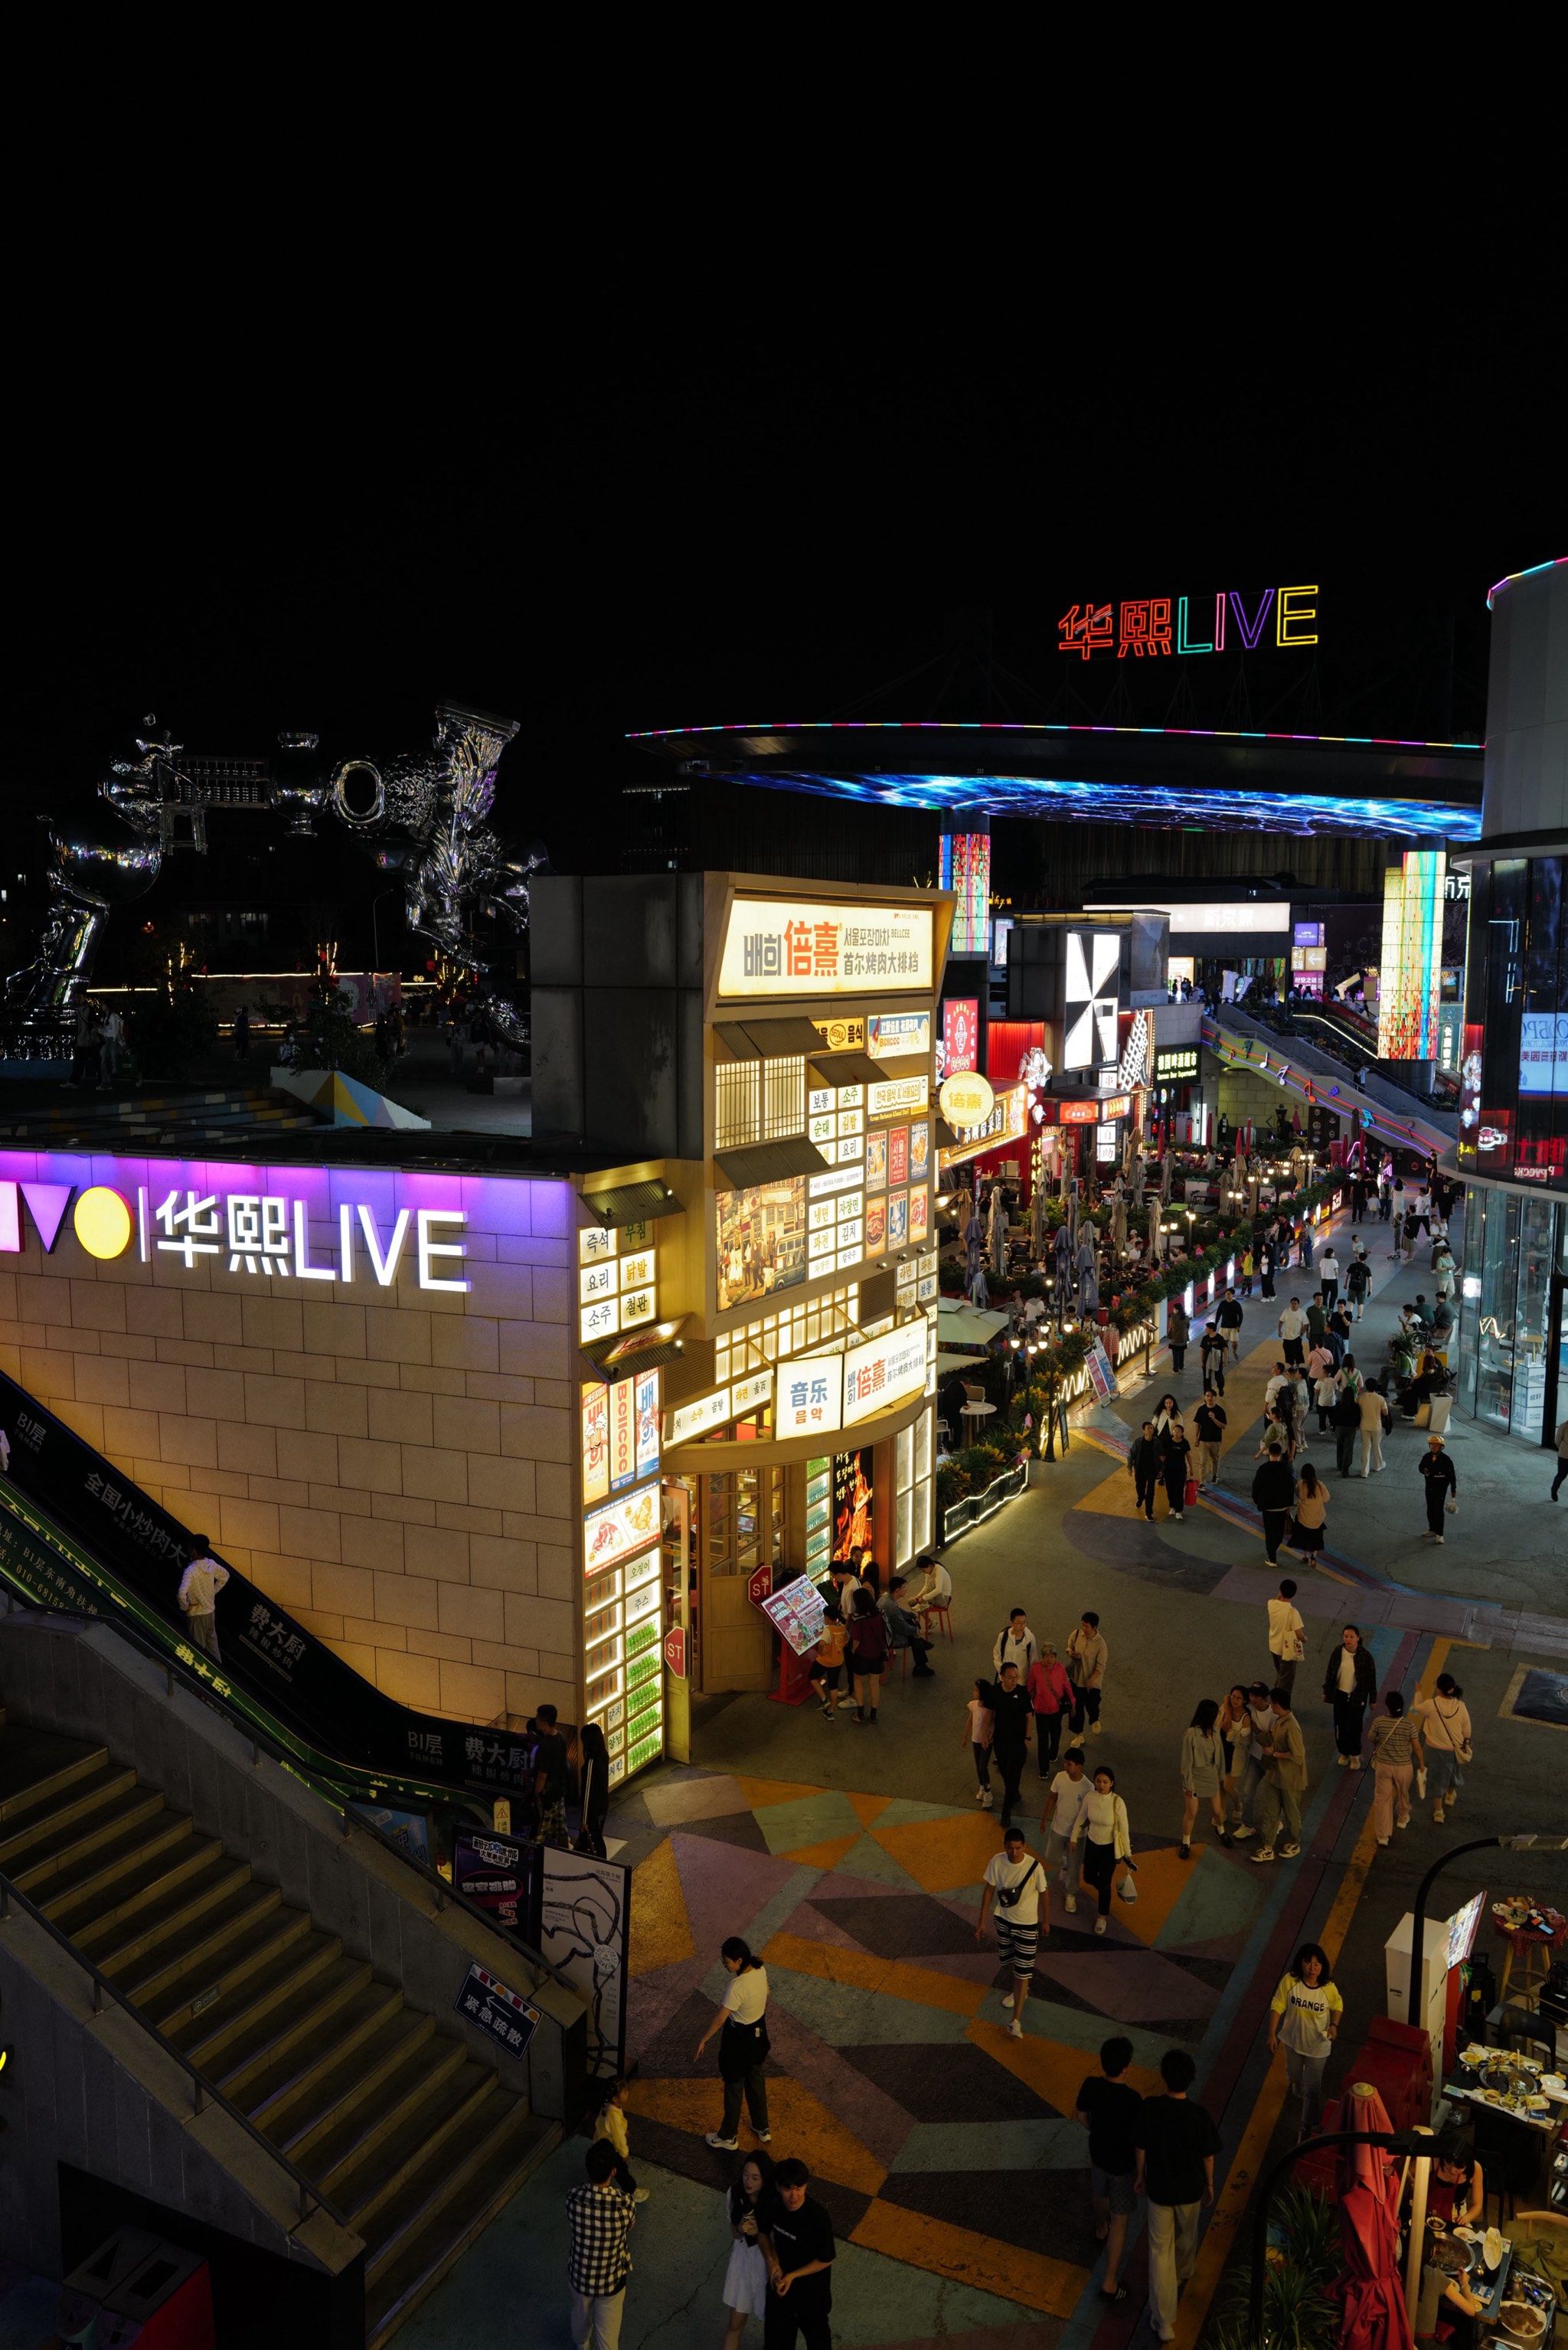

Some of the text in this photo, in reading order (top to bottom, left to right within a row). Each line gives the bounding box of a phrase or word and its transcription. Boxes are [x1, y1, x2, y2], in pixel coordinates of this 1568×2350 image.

[844, 927, 910, 946] 서울포장마차 BELLCEE
[844, 952, 919, 976] 首尔烤肉大排档
[848, 1025, 863, 1043] 음식
[813, 1092, 828, 1109] 보통
[843, 1087, 858, 1103] 소주
[814, 1119, 829, 1137] 순대
[842, 1113, 857, 1131] 김밥
[842, 1139, 856, 1156] 요리
[814, 1205, 828, 1224] 냉면
[839, 1198, 859, 1216] 자장면
[626, 1218, 646, 1244] 무침
[842, 1223, 856, 1242] 김치
[157, 1189, 472, 1293] 华熙LIVE
[586, 1232, 609, 1253] 즉석
[626, 1259, 648, 1282] 닭발
[586, 1269, 609, 1292] 요리
[626, 1293, 648, 1316] 철판
[589, 1305, 611, 1327] 소주
[736, 1386, 748, 1401] 라면
[790, 1378, 828, 1408] 音乐
[691, 1407, 704, 1422] 소주
[795, 1407, 823, 1425] 음악
[630, 1559, 649, 1579] 오징어
[635, 1595, 649, 1610] 주스
[668, 1644, 682, 1659] ST
[465, 1736, 528, 1771] 费大厨
[1290, 1995, 1325, 2019] ORANGE
[464, 1994, 523, 2048] 紧急疏散
